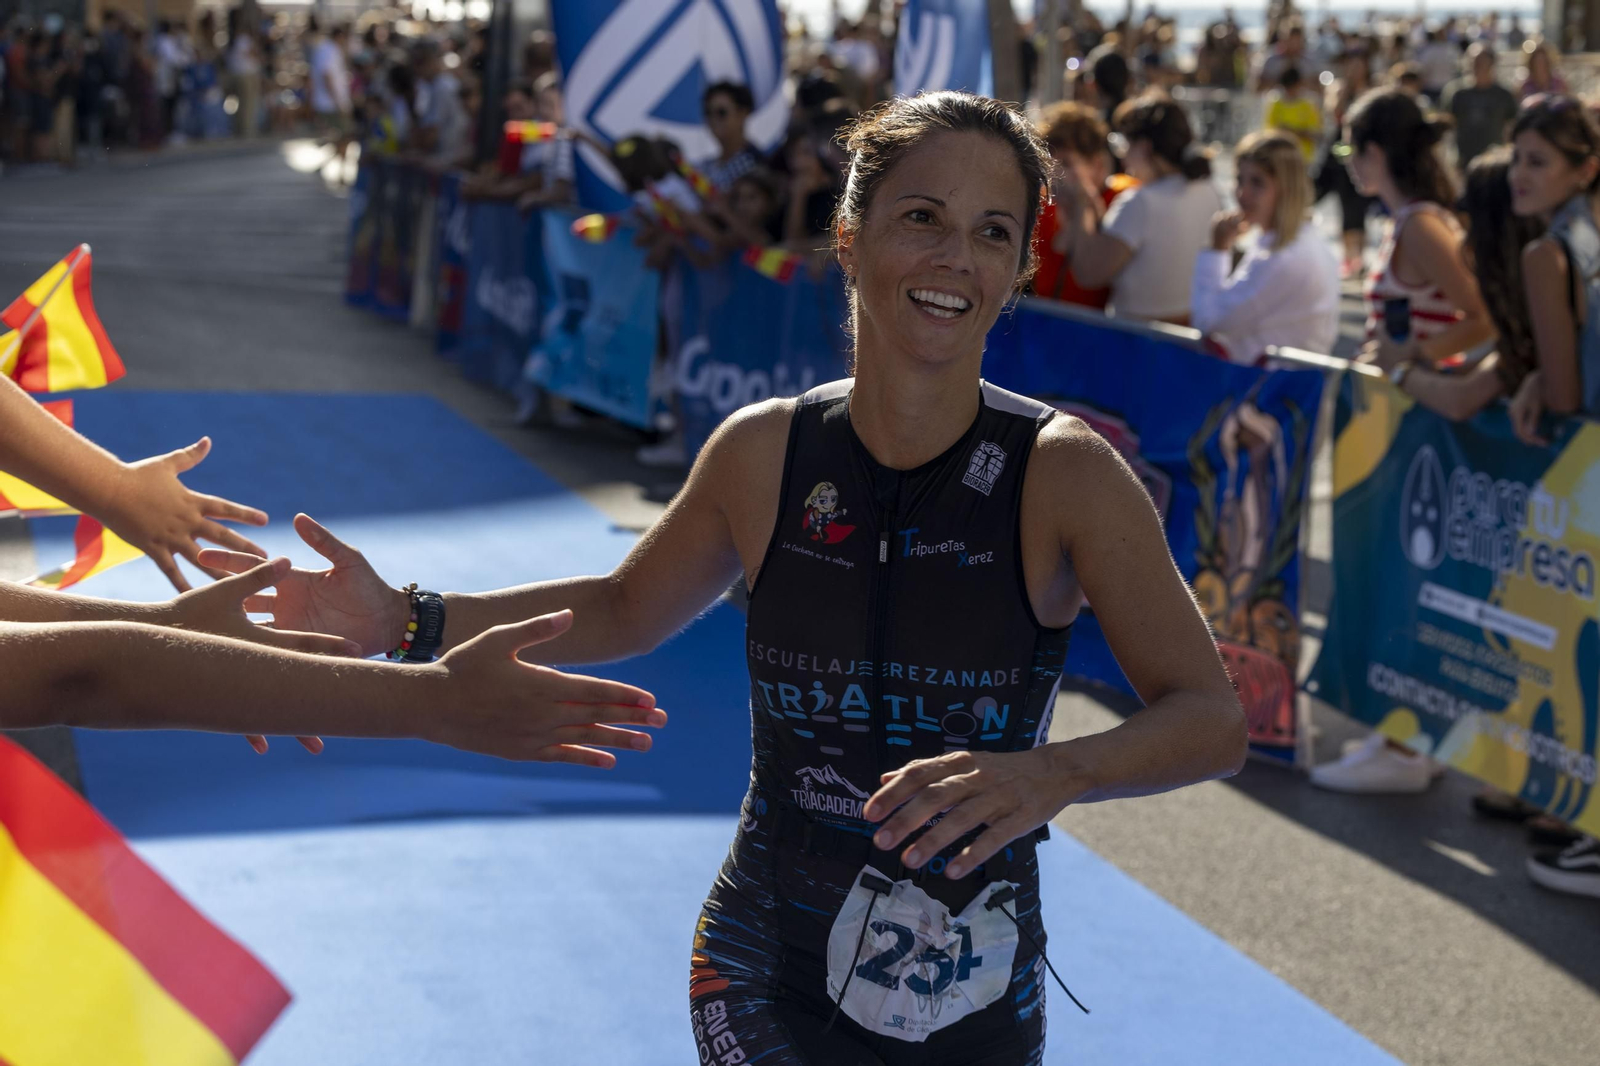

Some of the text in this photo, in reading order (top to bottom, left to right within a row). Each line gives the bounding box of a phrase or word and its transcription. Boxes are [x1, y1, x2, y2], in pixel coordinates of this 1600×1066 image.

[963, 474, 991, 495] BIORACER
[1447, 465, 1570, 541] para tu
[957, 551, 994, 568] Xerez
[1447, 514, 1595, 601] empresa
[749, 639, 843, 675] ESCUELA
